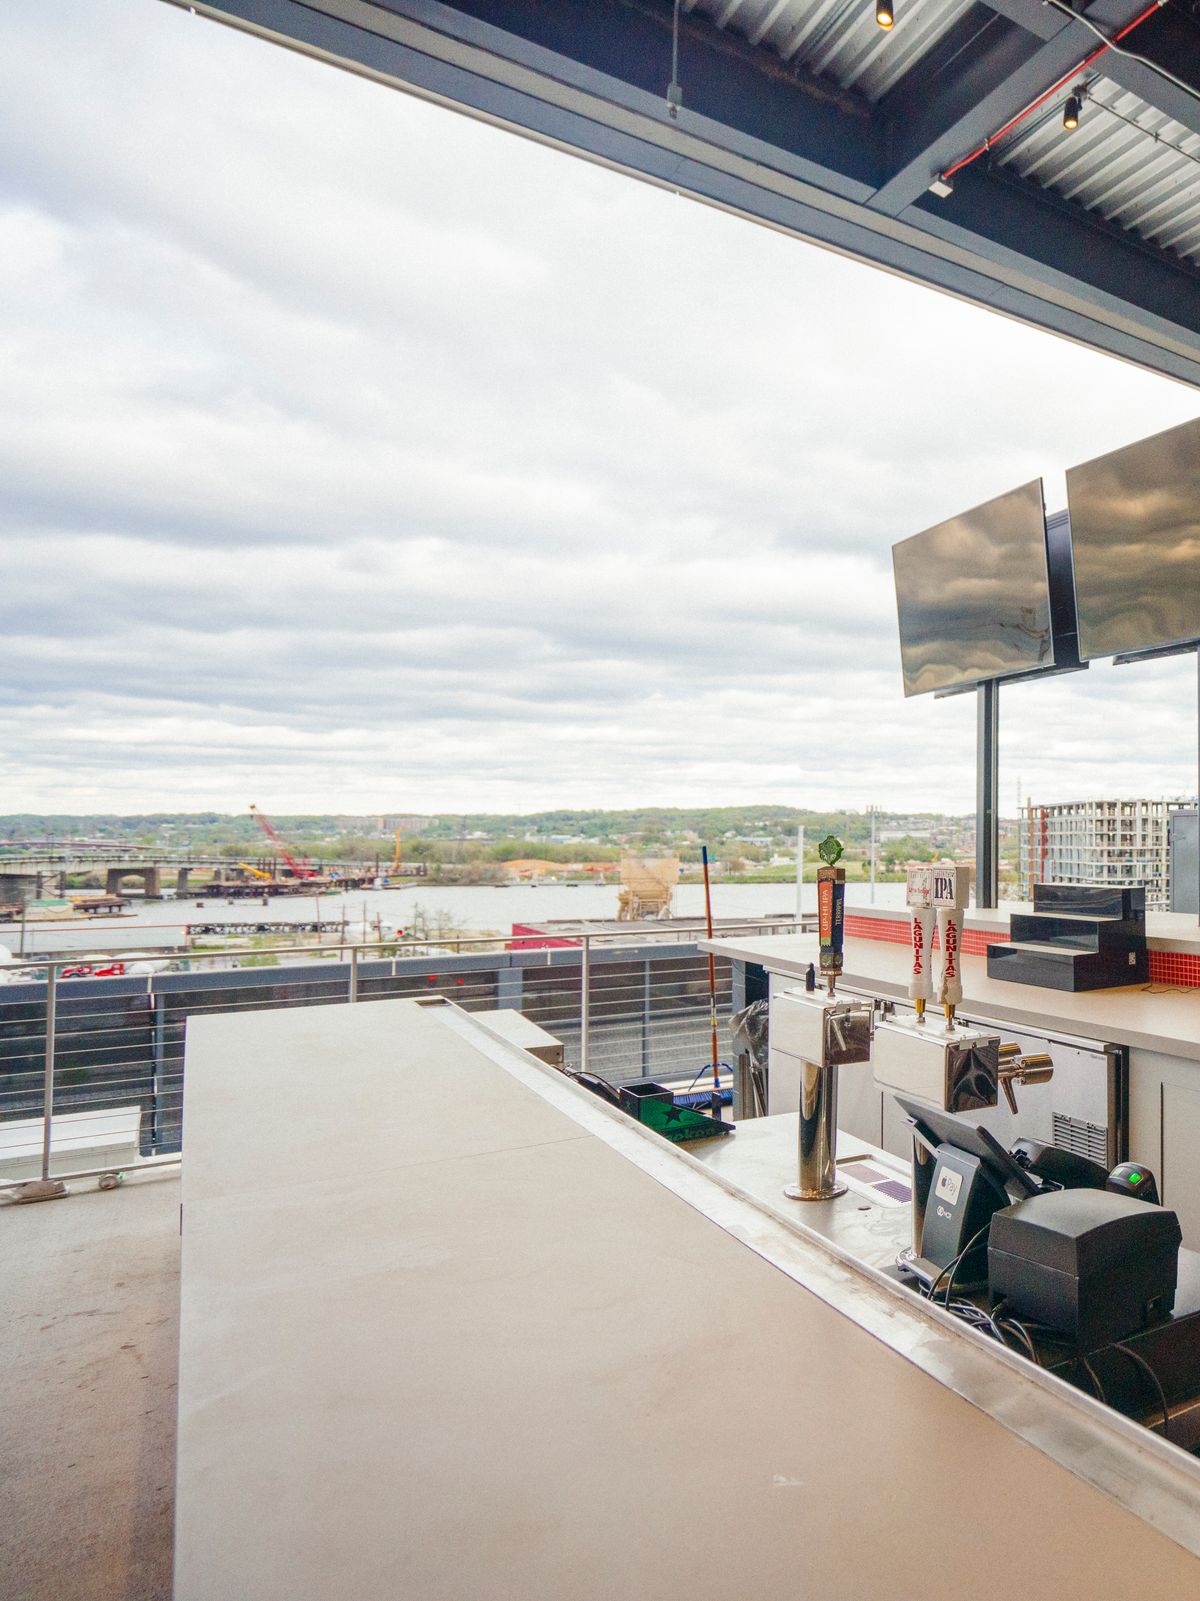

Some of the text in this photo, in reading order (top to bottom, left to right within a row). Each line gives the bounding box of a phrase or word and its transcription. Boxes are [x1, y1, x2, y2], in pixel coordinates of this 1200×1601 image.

[934, 877, 954, 900] IPA
[913, 917, 923, 975] LAGUNITAS
[945, 919, 957, 978] LAGUNITAS
[947, 1177, 958, 1196] Pay
